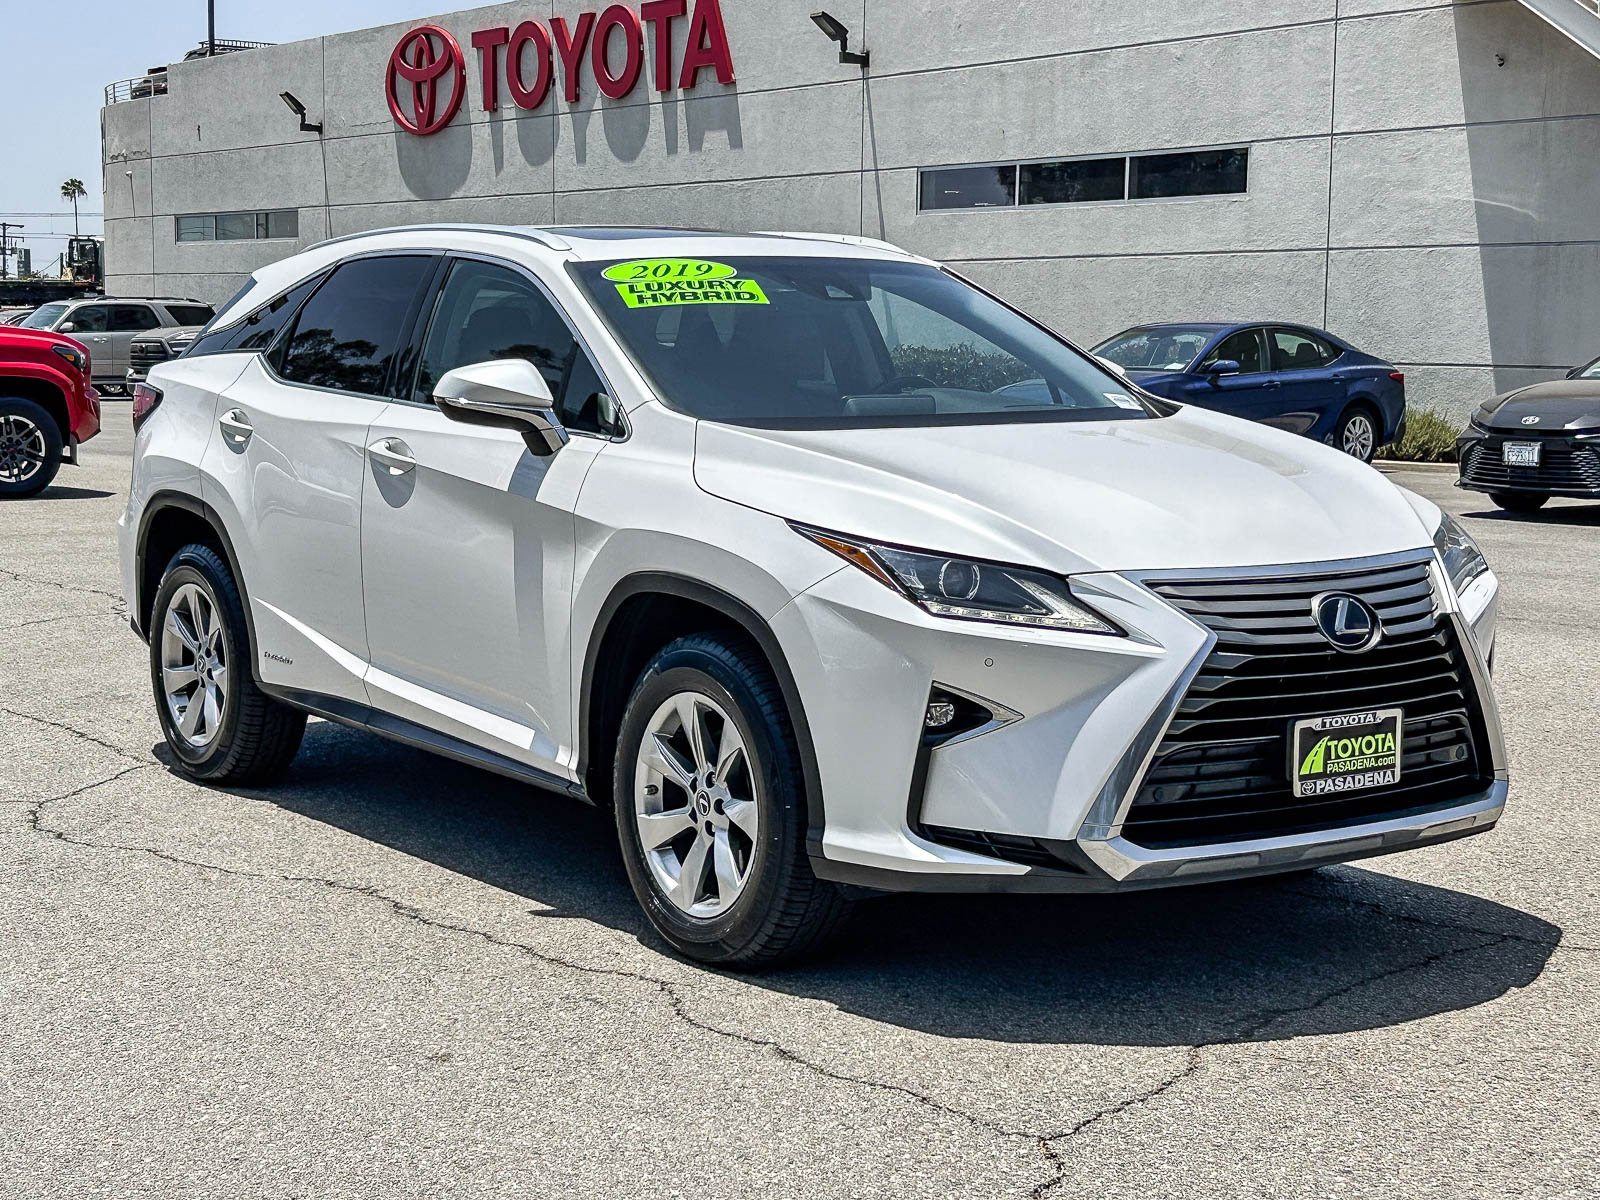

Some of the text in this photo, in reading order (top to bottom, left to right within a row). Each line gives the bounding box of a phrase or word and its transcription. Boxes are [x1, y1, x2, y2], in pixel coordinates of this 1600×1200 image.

[471, 0, 736, 112] TOYOTA
[630, 263, 713, 279] 2019
[628, 280, 746, 294] LUXURY
[637, 291, 760, 304] HYBRID
[1323, 713, 1375, 728] TOYOTA
[1327, 732, 1396, 760] TOYOTA
[1326, 756, 1396, 774] PASADENA.com
[1316, 770, 1394, 794] PASADENA
